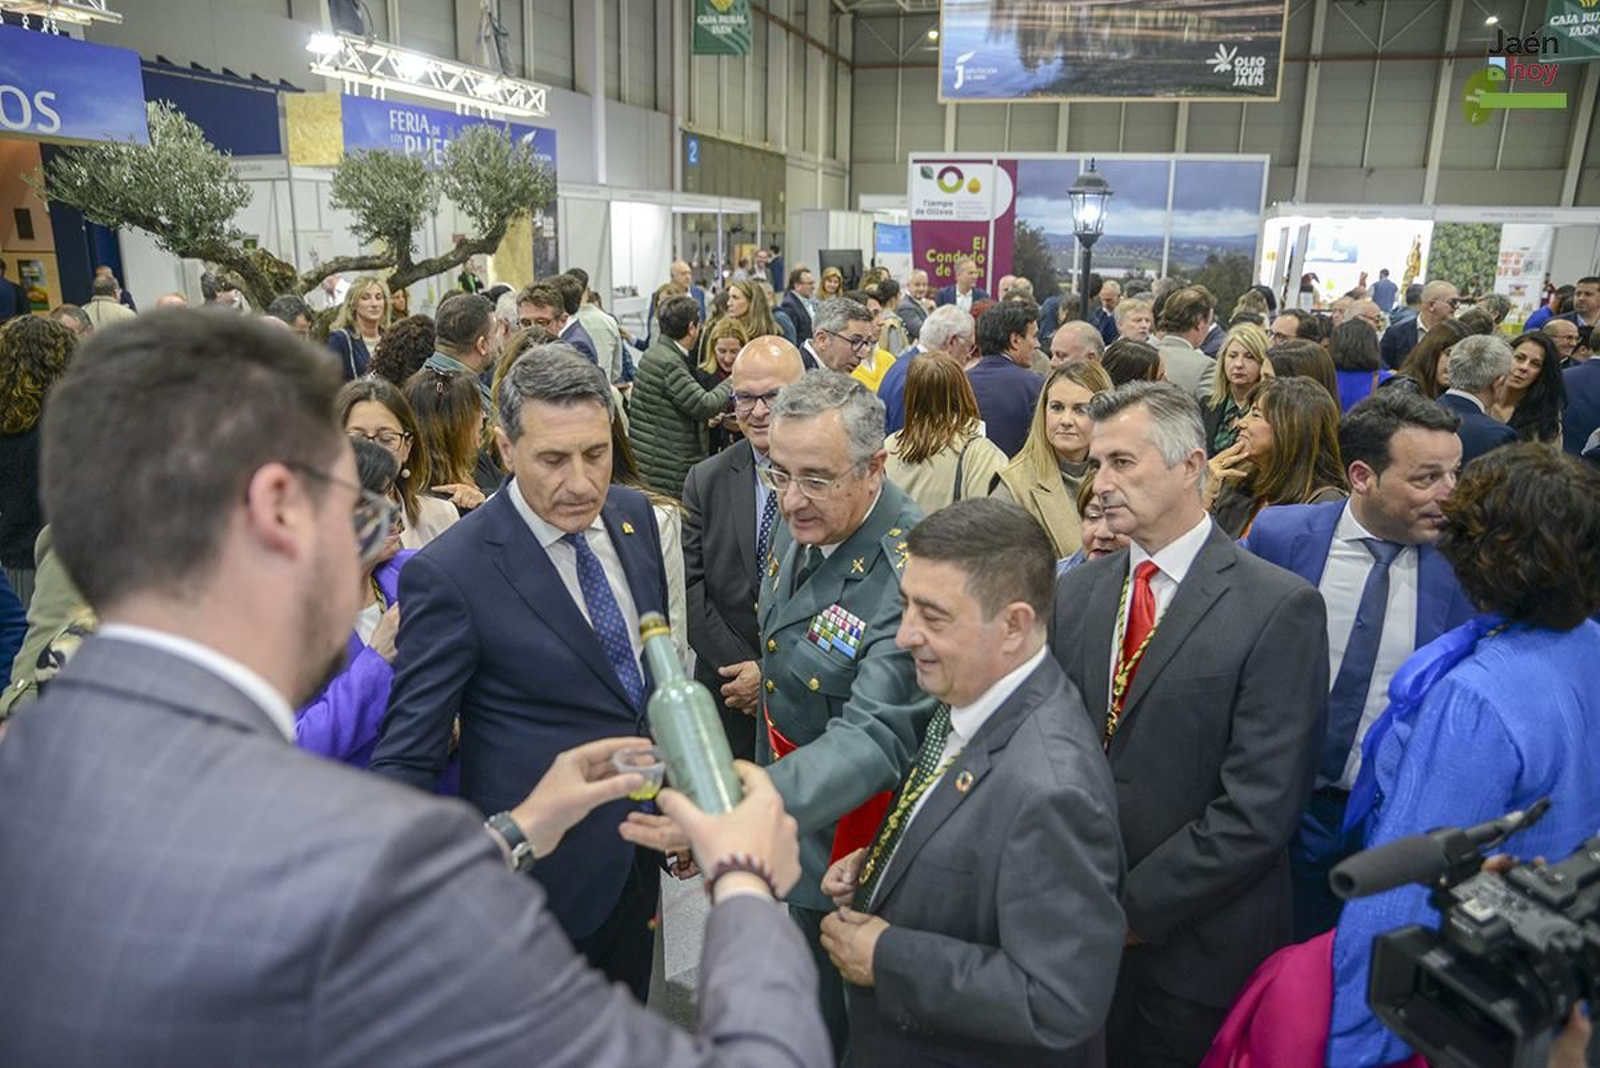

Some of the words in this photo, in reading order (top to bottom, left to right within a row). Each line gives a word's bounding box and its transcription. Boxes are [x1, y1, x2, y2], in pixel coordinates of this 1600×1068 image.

[1581, 12, 1600, 23] RU
[1234, 56, 1266, 67] OLEO
[1234, 67, 1264, 77] TOUR
[389, 109, 430, 135] FERIA
[689, 140, 698, 163] 2
[922, 199, 954, 208] Tiempo
[915, 208, 925, 216] de
[926, 208, 954, 216] Olivos
[973, 236, 986, 251] El
[935, 262, 952, 277] de
